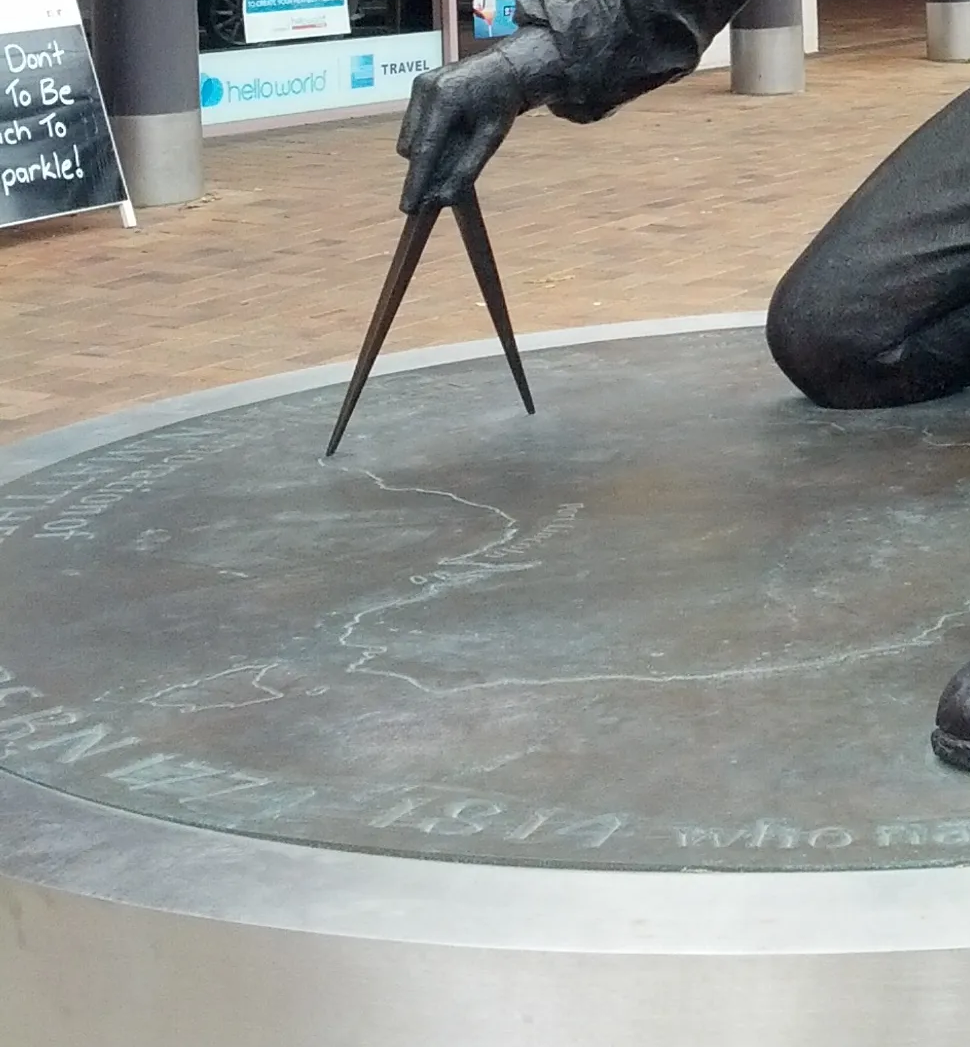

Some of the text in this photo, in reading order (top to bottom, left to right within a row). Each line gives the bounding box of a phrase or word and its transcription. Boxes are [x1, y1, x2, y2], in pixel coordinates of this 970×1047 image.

[5, 40, 65, 73] Don't
[5, 77, 75, 108] To Be
[226, 70, 327, 103] helloworld
[381, 60, 430, 75] TRAVEL
[39, 112, 67, 138] To
[672, 818, 853, 849] who
